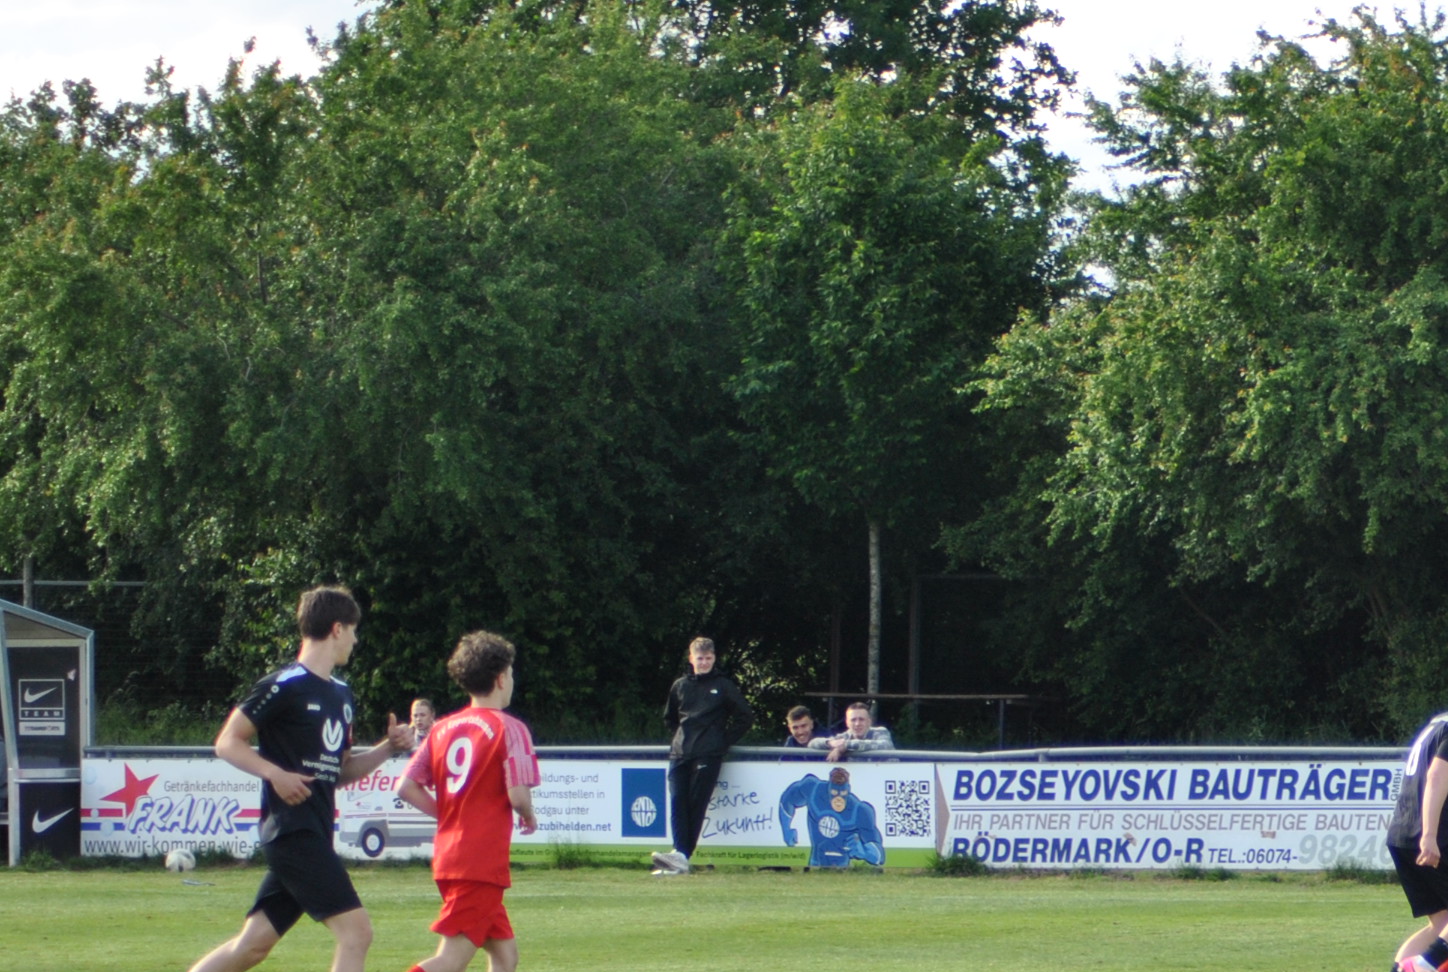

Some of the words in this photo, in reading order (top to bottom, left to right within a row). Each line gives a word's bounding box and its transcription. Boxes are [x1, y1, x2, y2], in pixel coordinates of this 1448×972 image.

[446, 736, 473, 794] 9
[164, 780, 260, 792] Getränkefachhandel
[541, 773, 578, 785] ildungs-
[581, 774, 599, 783] und
[953, 769, 1177, 801] BOZSEYOVSKI
[1188, 763, 1392, 800] BAUTRÄGER
[597, 790, 605, 799] in
[128, 794, 240, 835] FRANK
[532, 805, 563, 817] odgau
[565, 806, 589, 815] unter
[954, 813, 982, 830] IHR
[989, 813, 1070, 831] PARTNER
[1078, 809, 1114, 830] FÜR
[1121, 809, 1308, 831] SCHLÜSSELFERTIGE
[702, 807, 773, 838] Zukunft!
